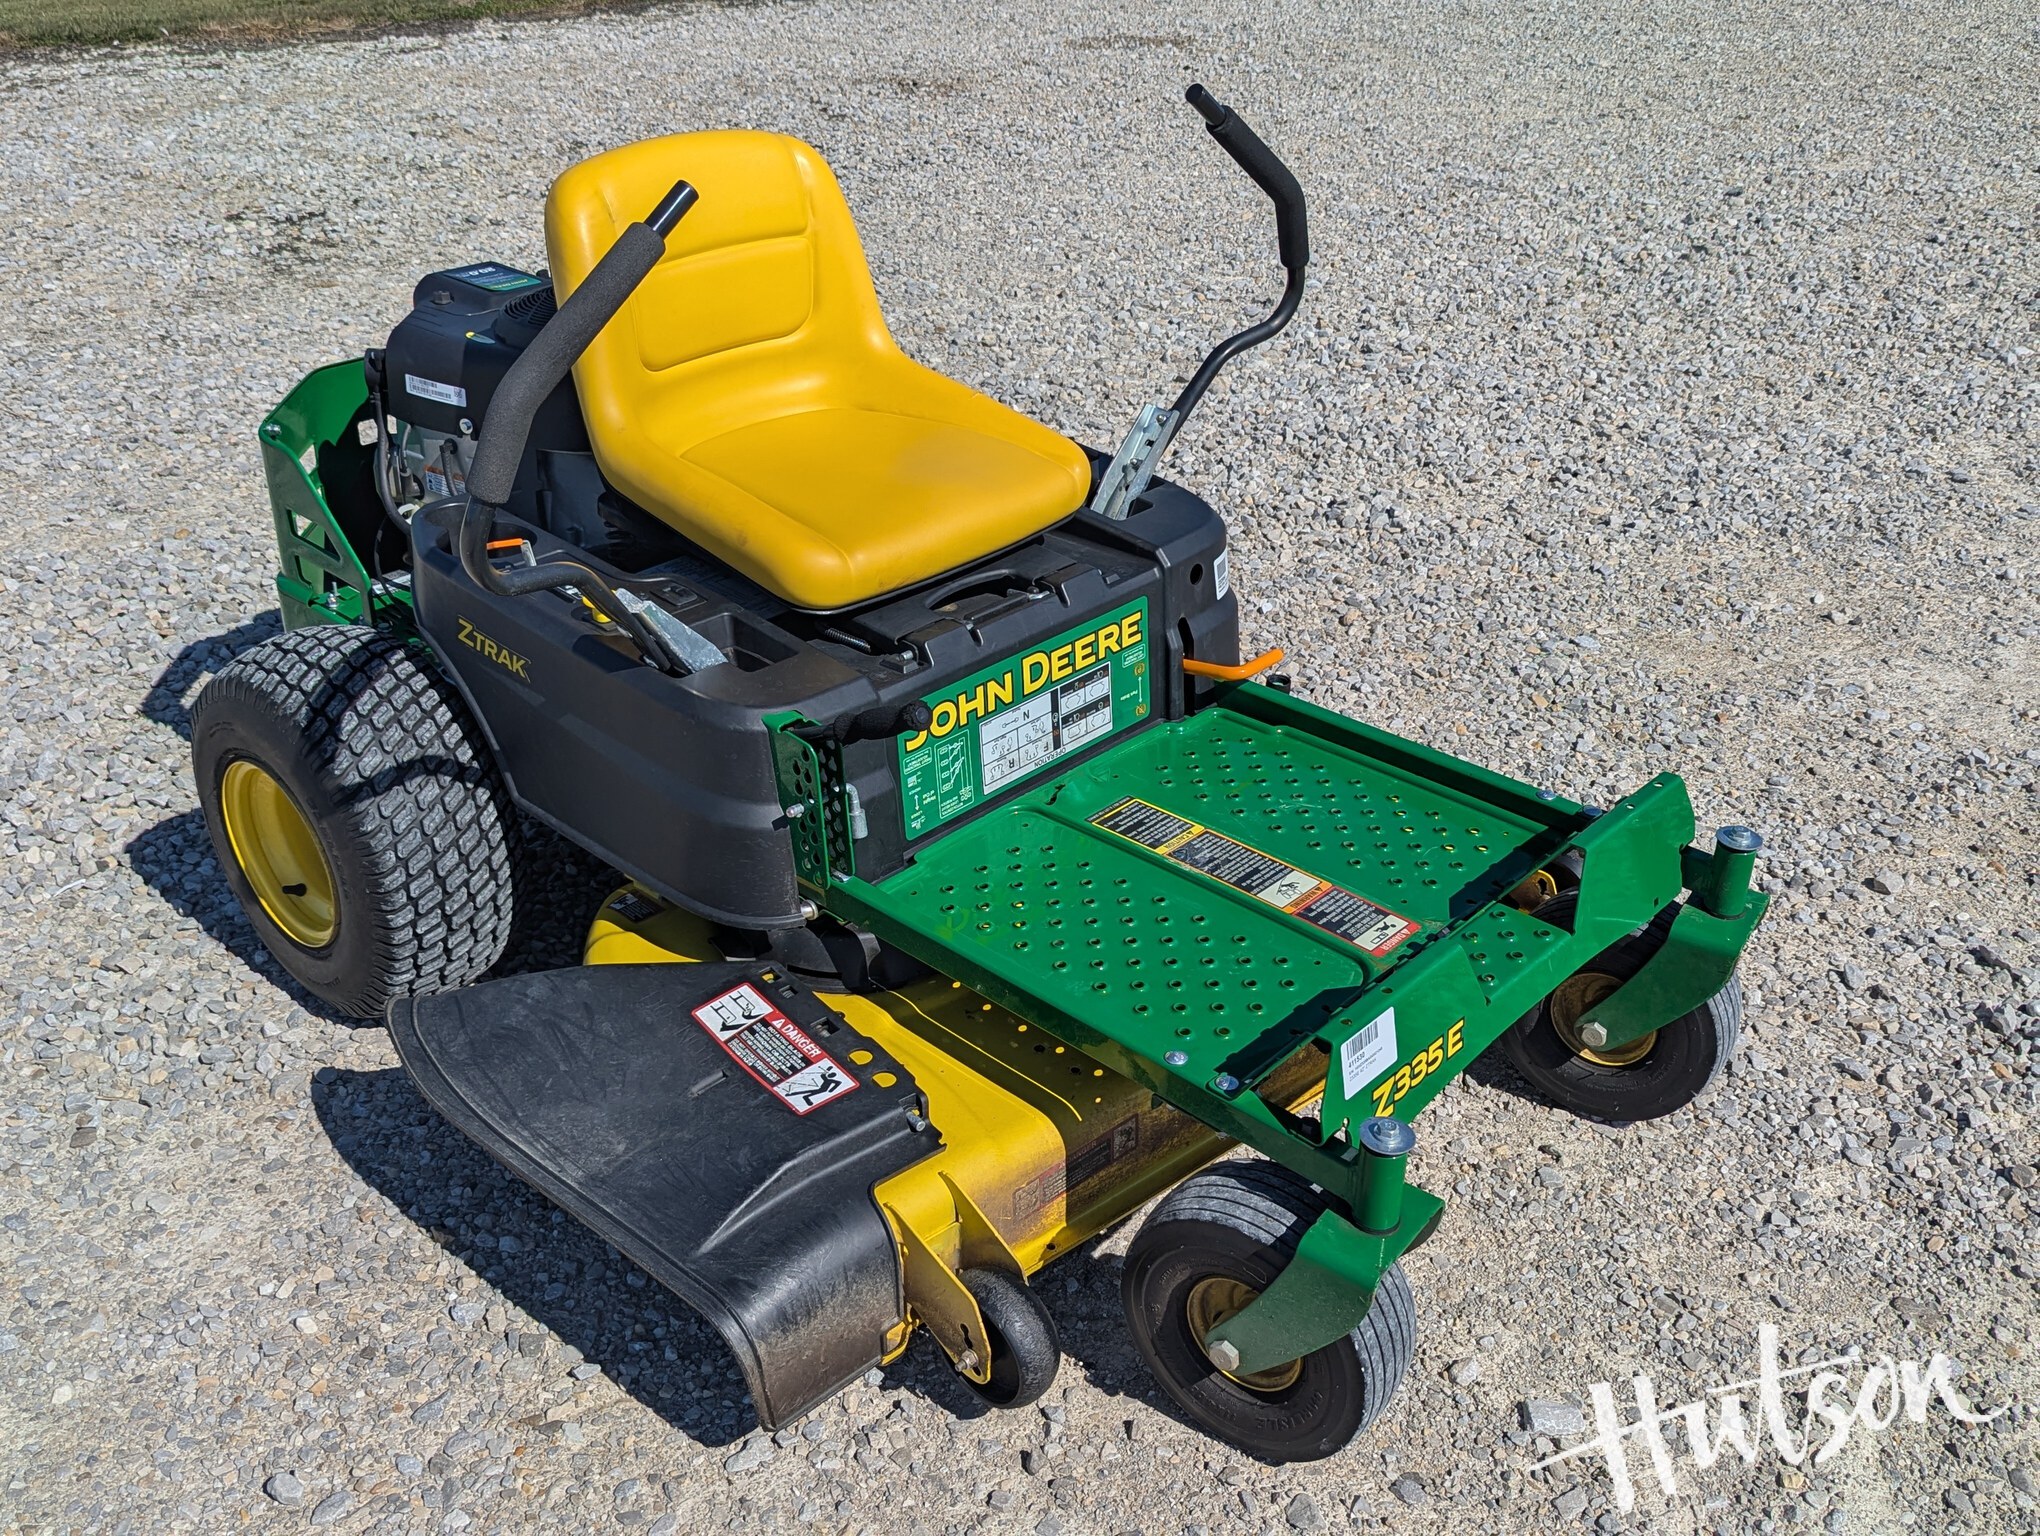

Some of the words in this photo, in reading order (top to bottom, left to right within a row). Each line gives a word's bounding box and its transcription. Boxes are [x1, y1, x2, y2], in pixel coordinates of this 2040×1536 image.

[457, 618, 528, 678] ZTRAK
[1022, 611, 1142, 694] DEERE
[1022, 709, 1029, 721] N
[1008, 757, 1014, 769] R
[1034, 747, 1068, 768] OPERATION
[1292, 890, 1319, 909] WARNING
[1381, 932, 1407, 950] DANGER
[782, 1024, 821, 1057] DANGER
